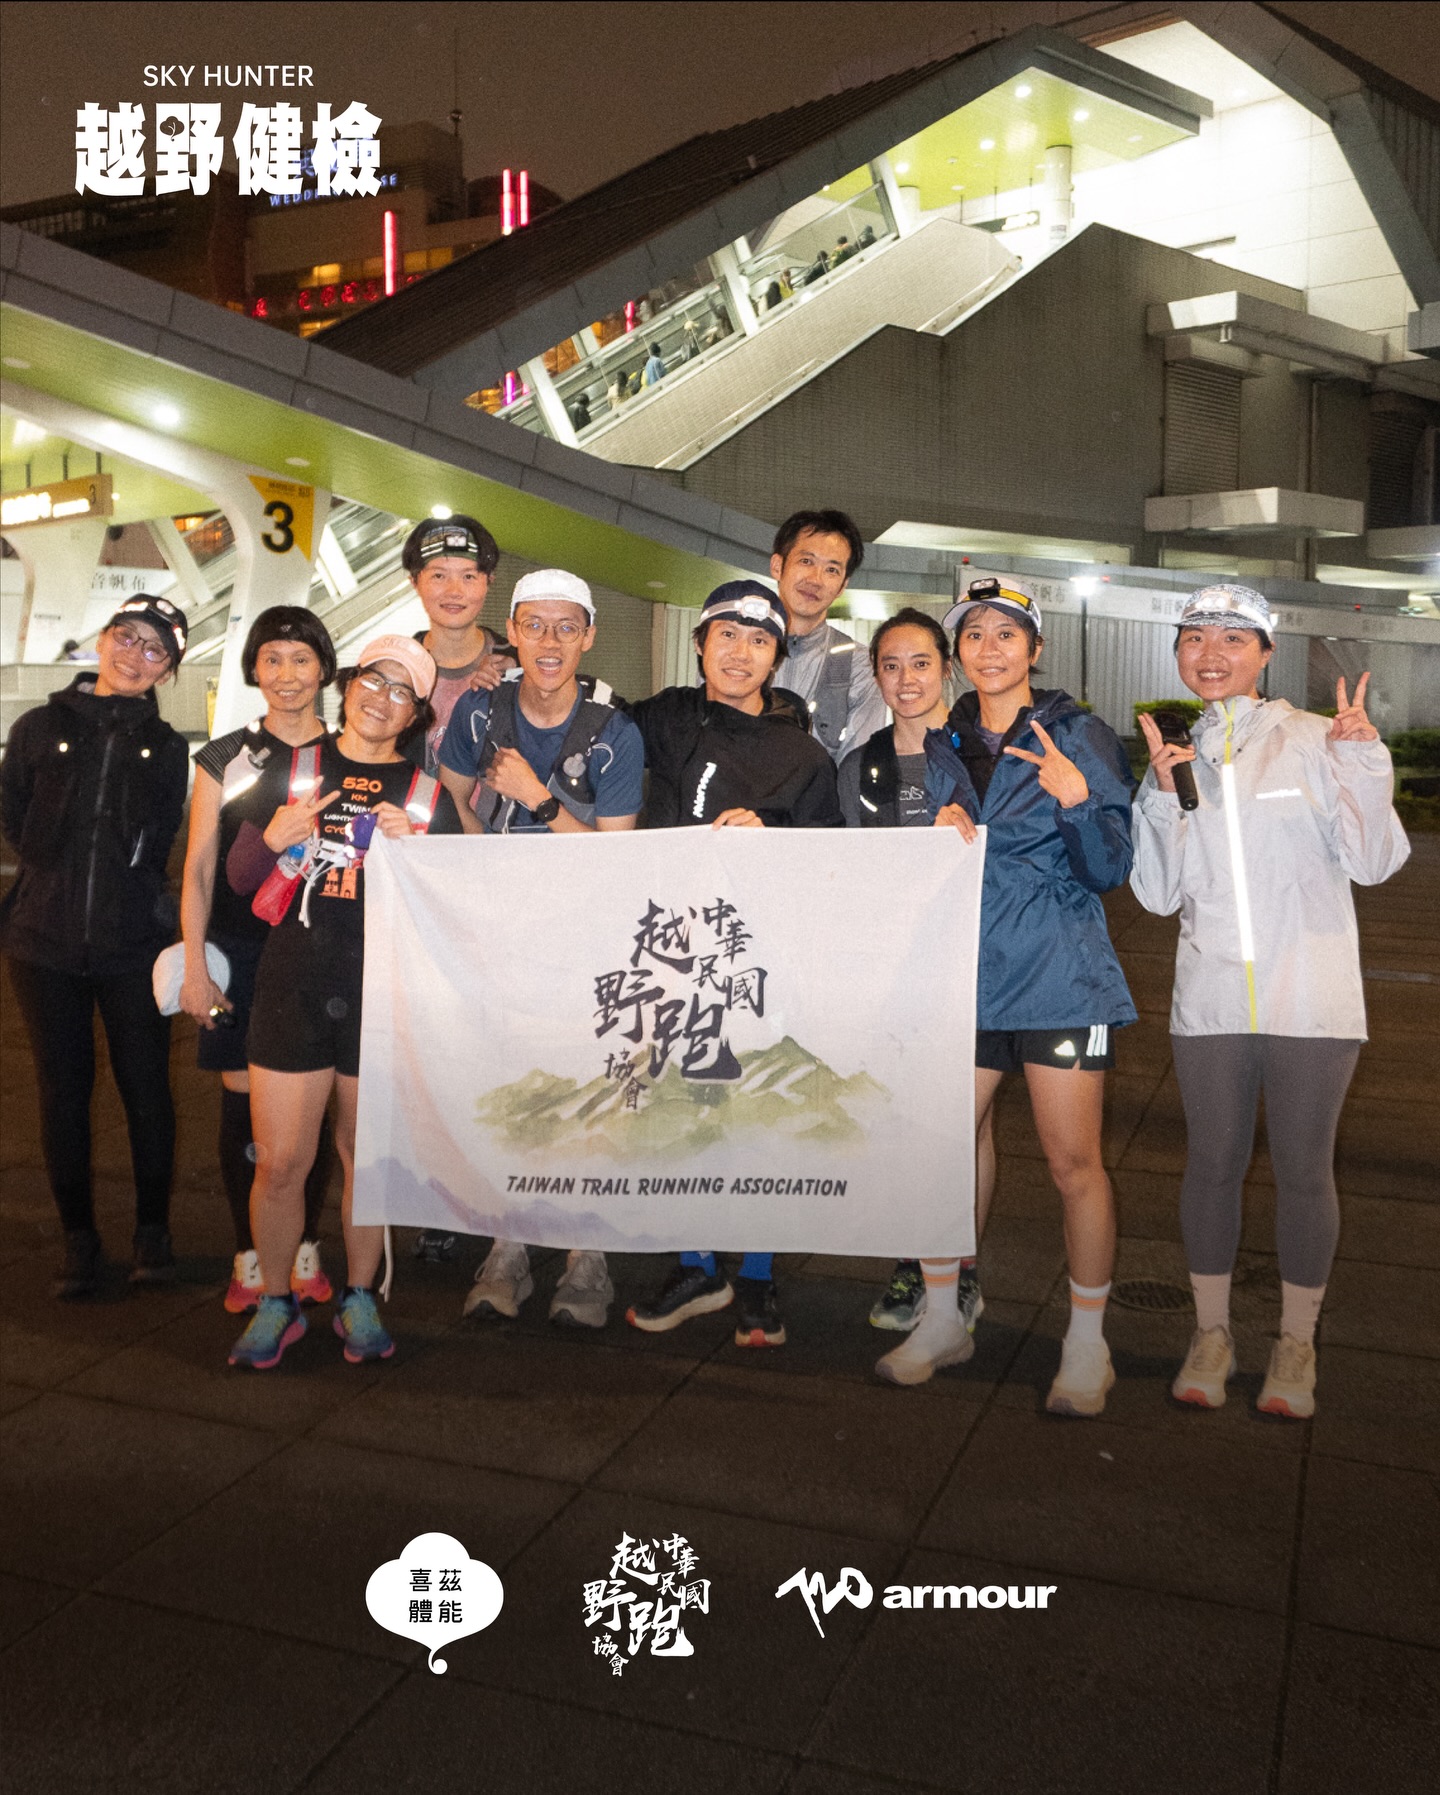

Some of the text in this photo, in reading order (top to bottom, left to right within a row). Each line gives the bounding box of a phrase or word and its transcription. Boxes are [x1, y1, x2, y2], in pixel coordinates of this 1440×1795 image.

[89, 484, 97, 504] 3
[261, 500, 295, 554] 3
[341, 776, 383, 794] 520
[351, 793, 368, 803] KM
[692, 897, 769, 1019] 中華民國
[593, 898, 742, 1081] 越野跑
[506, 1175, 849, 1198] TAIWAN TRAIL RUNNING ASSOCIATION
